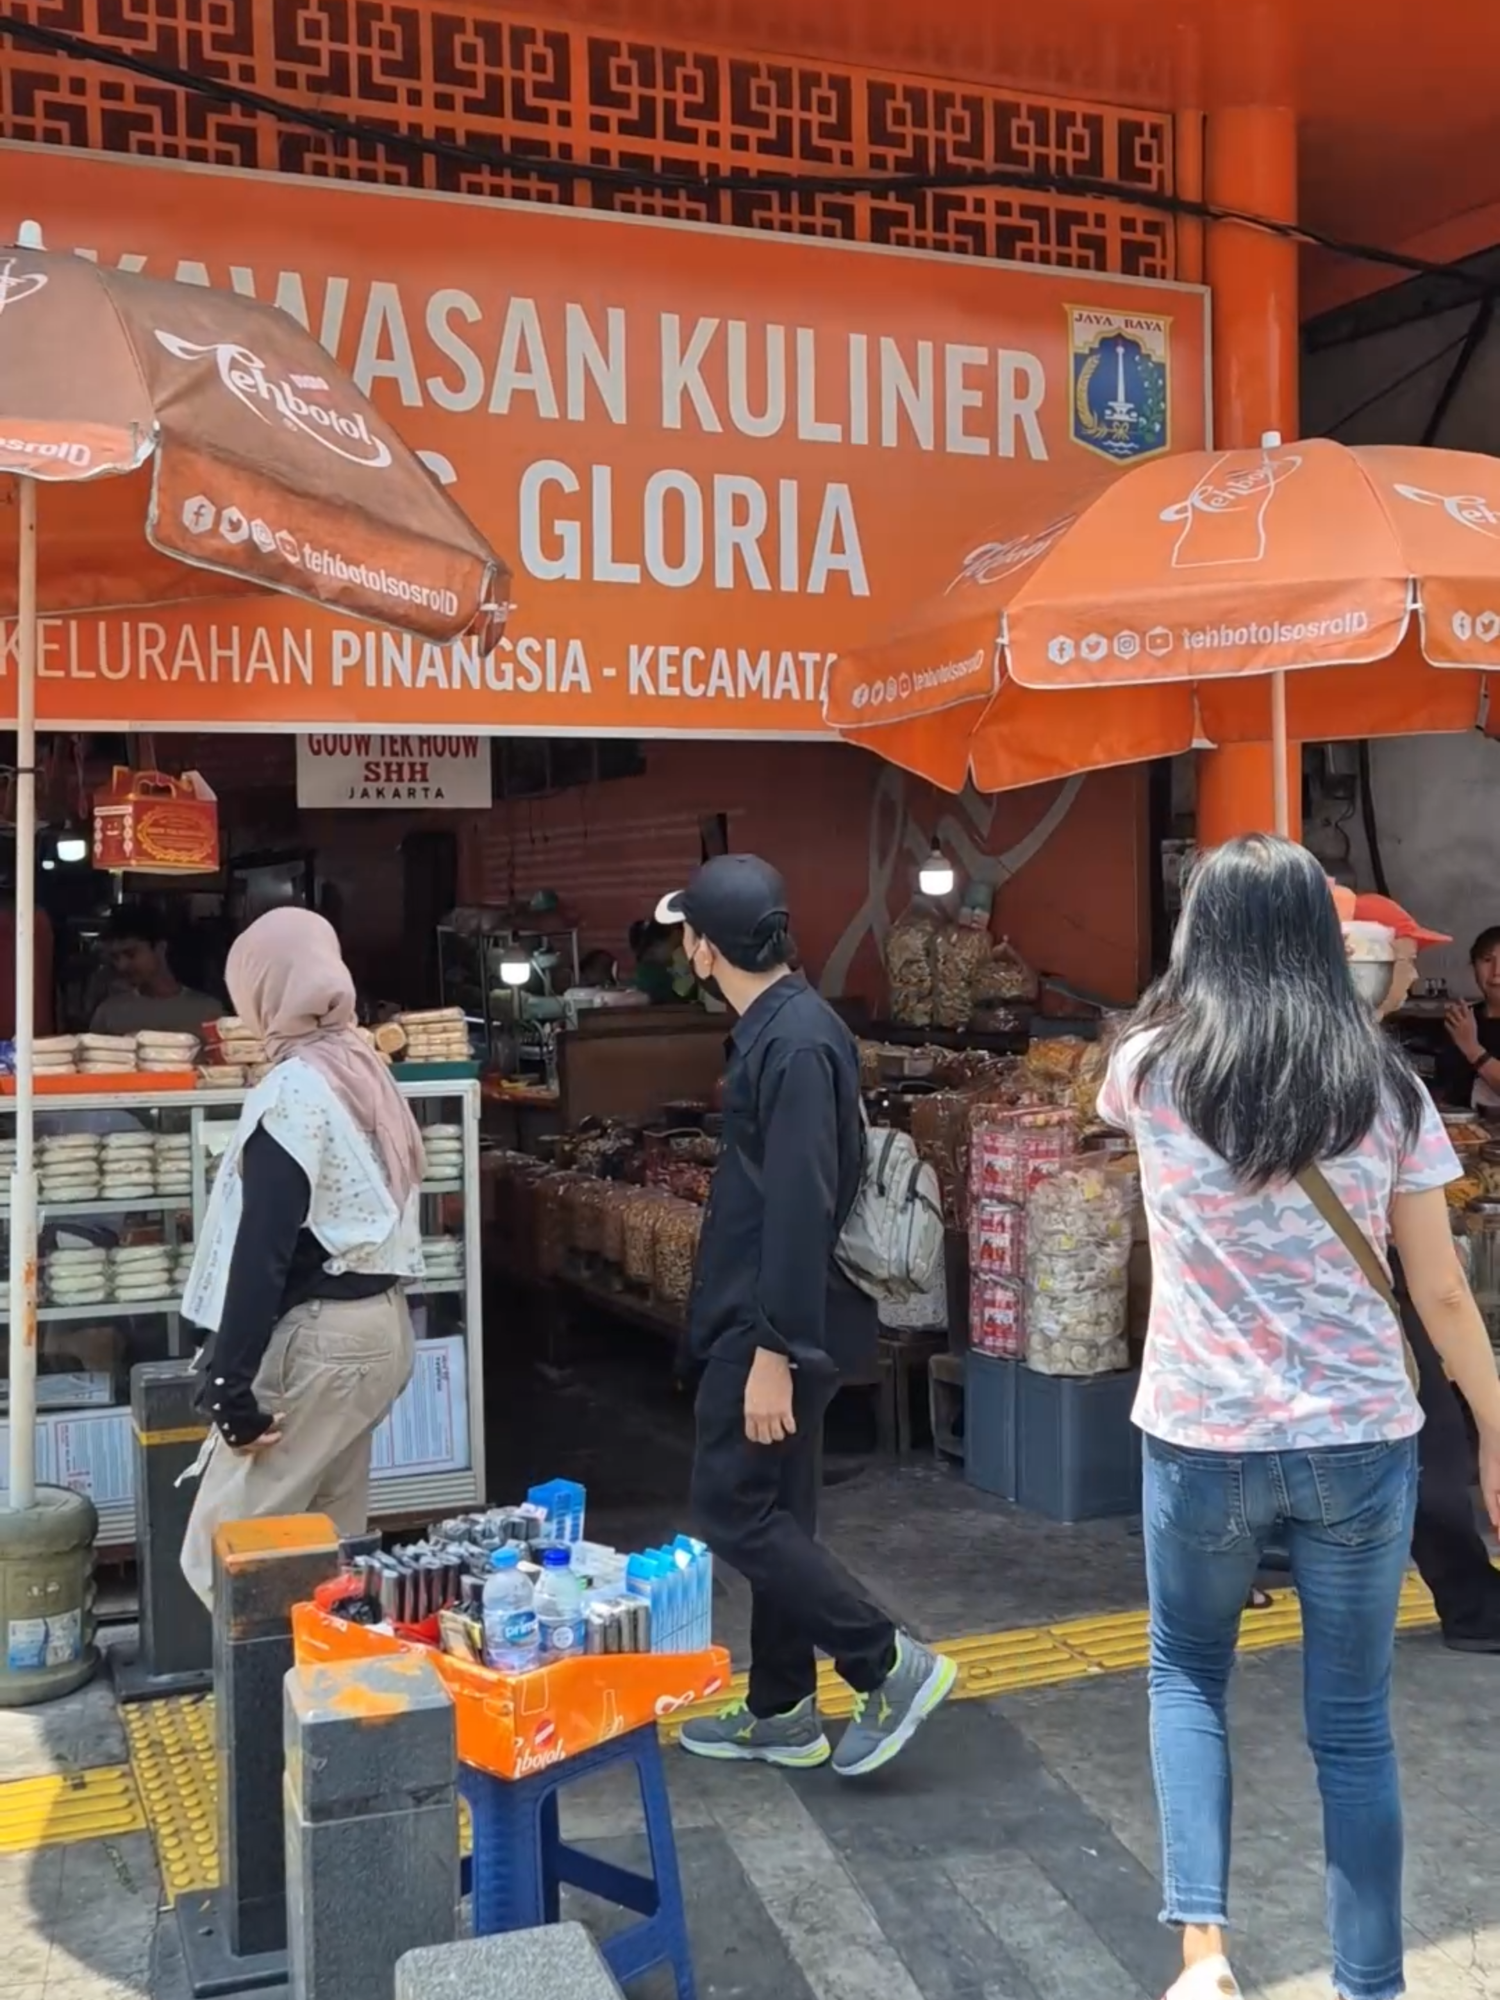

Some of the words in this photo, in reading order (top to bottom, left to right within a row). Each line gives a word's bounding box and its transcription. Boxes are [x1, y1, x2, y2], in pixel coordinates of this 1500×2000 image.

[1075, 312, 1114, 327] JAYA
[1124, 318, 1163, 333] RAYA
[660, 312, 1049, 462] KULINER
[519, 459, 870, 597] GLORIA
[303, 543, 458, 617] tehbotolsosroID
[0, 618, 313, 686] KELURAHAN
[332, 630, 591, 694] PINANGSIA
[1181, 611, 1368, 650] tehbotolsosroID
[348, 787, 445, 800] JAKARTA
[364, 761, 429, 783] SHH
